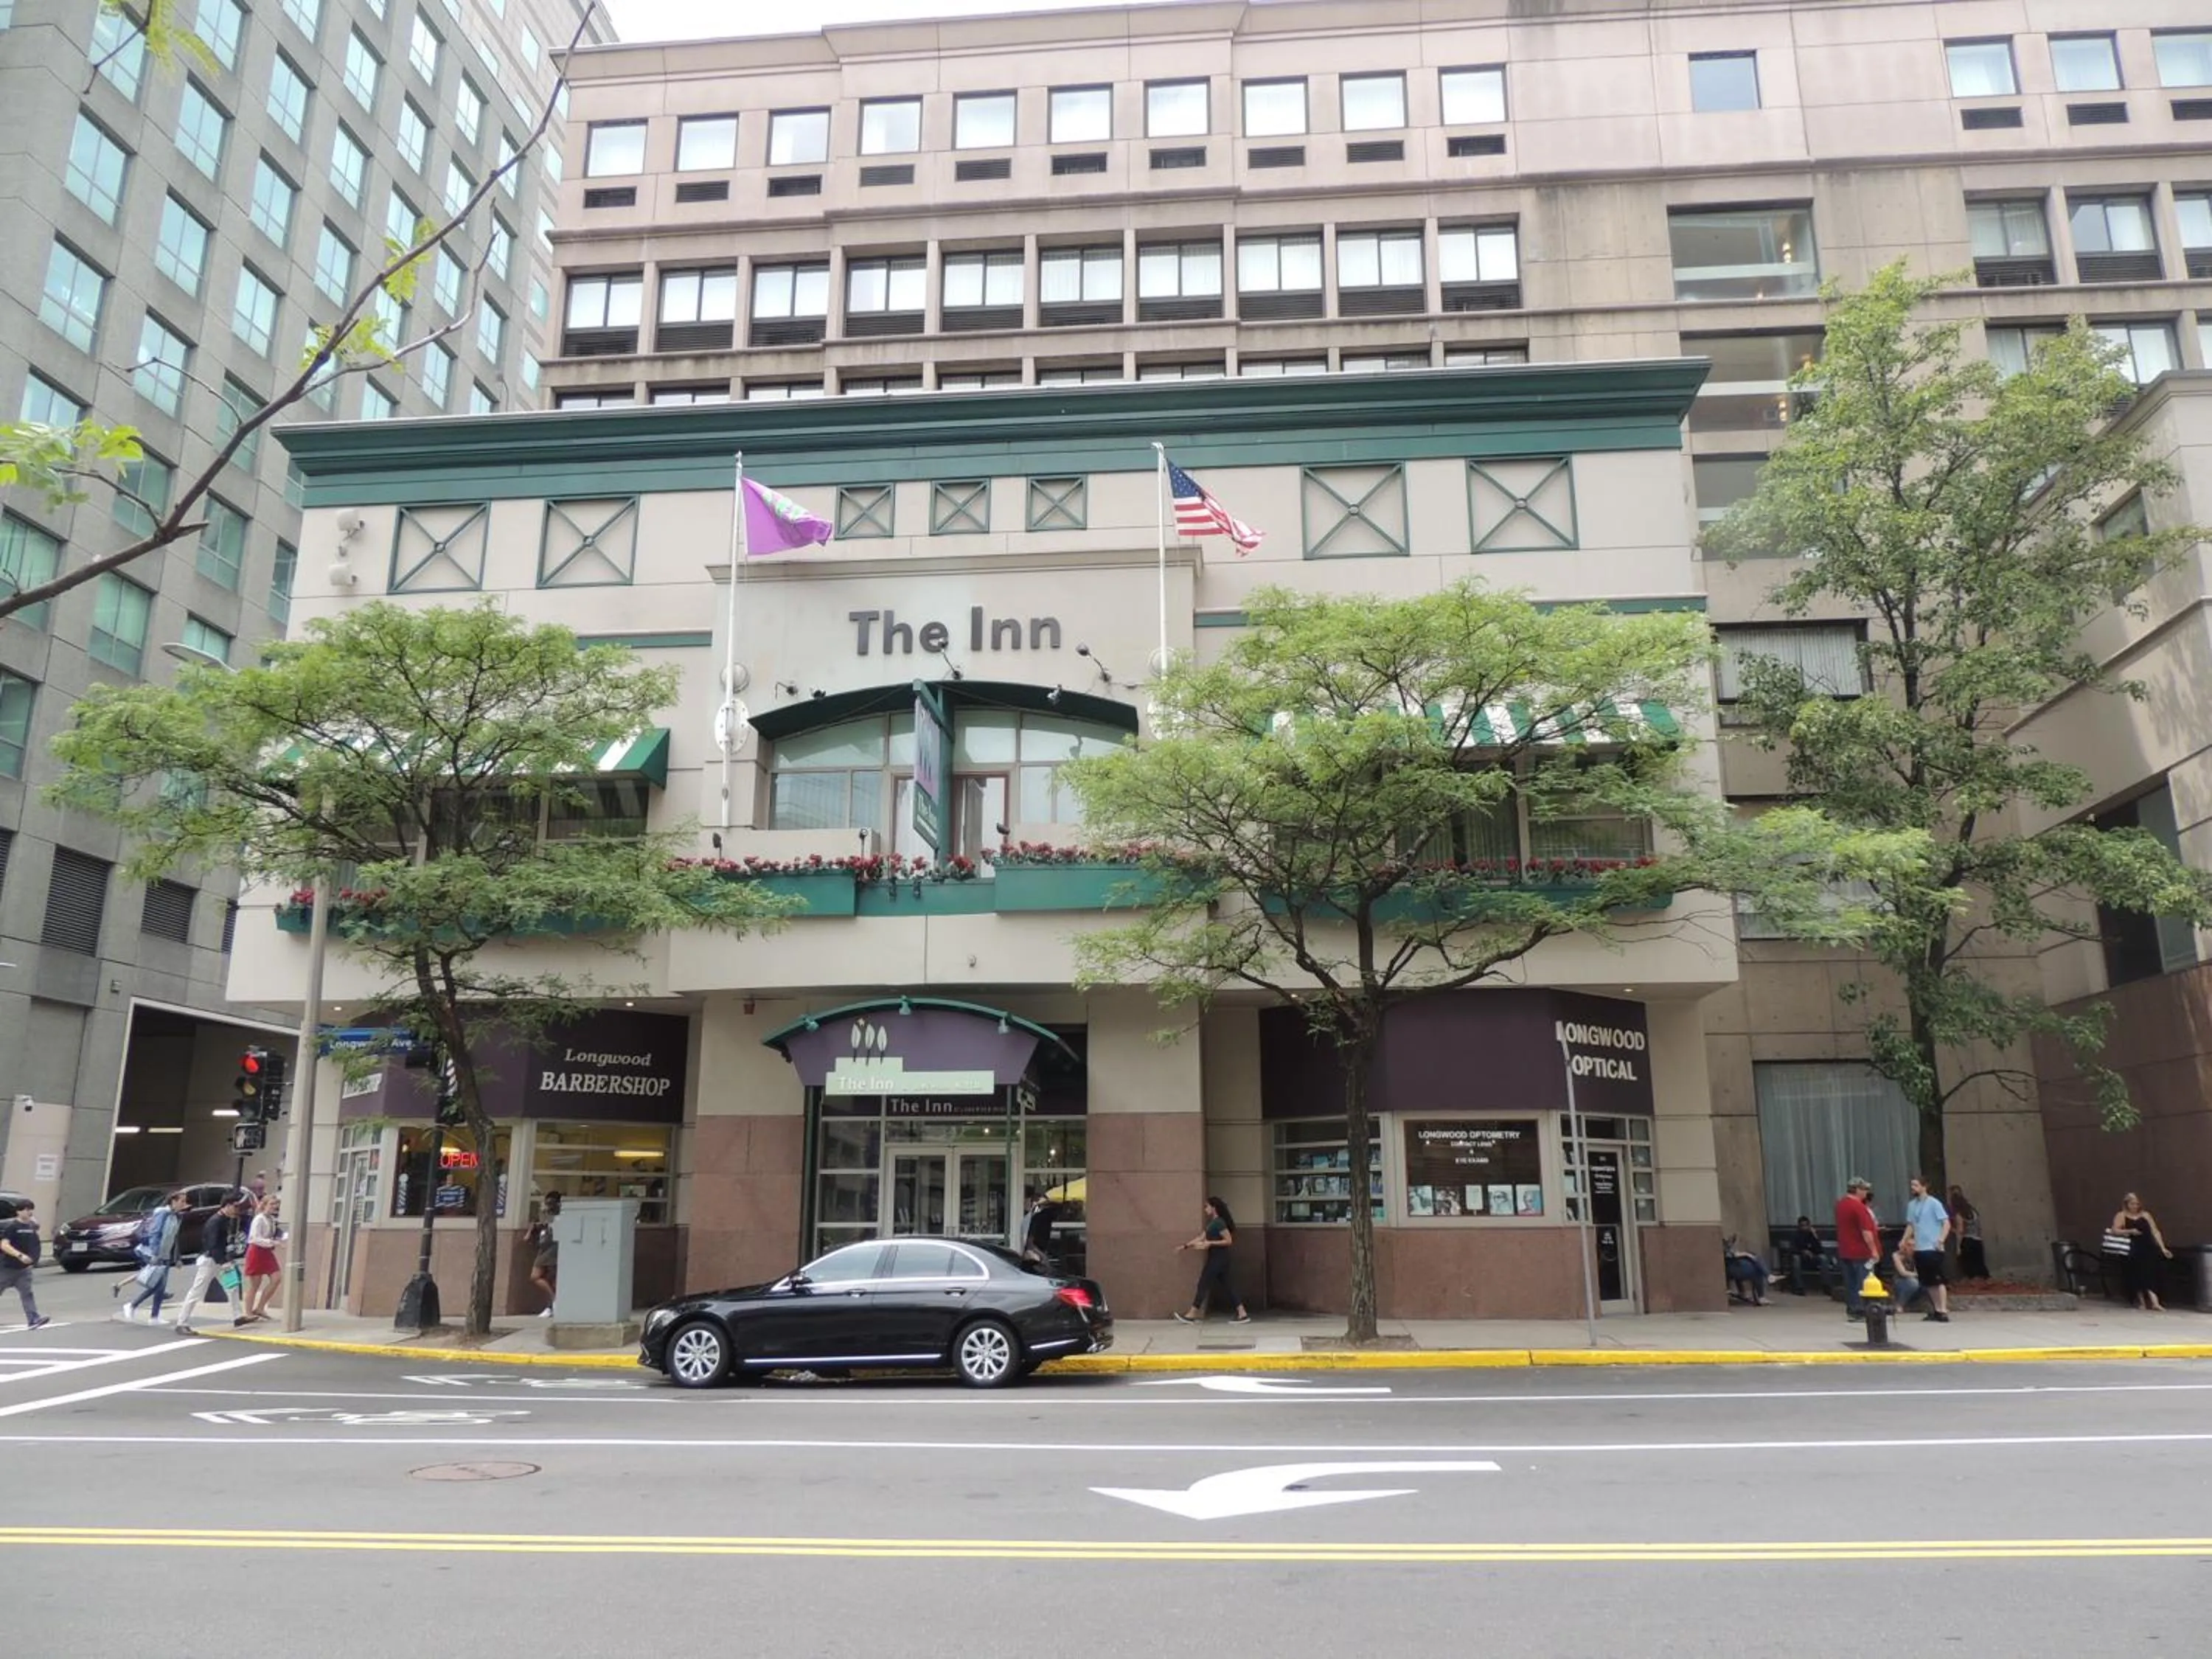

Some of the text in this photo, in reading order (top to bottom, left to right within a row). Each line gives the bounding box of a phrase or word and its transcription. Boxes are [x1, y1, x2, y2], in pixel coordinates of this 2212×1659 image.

[849, 605, 1060, 656] The Inn
[329, 1037, 389, 1051] Longwd
[566, 1048, 652, 1066] Longwood
[1571, 1054, 1638, 1081] OPTICAL
[540, 1071, 670, 1096] BARBERSHOP
[838, 1077, 866, 1091] The
[870, 1076, 894, 1091] Inn
[891, 1098, 919, 1113] The
[925, 1098, 953, 1113] Inn
[1418, 1130, 1521, 1139] LONGWOOD OPTOMETRY
[439, 1152, 478, 1168] OPEN
